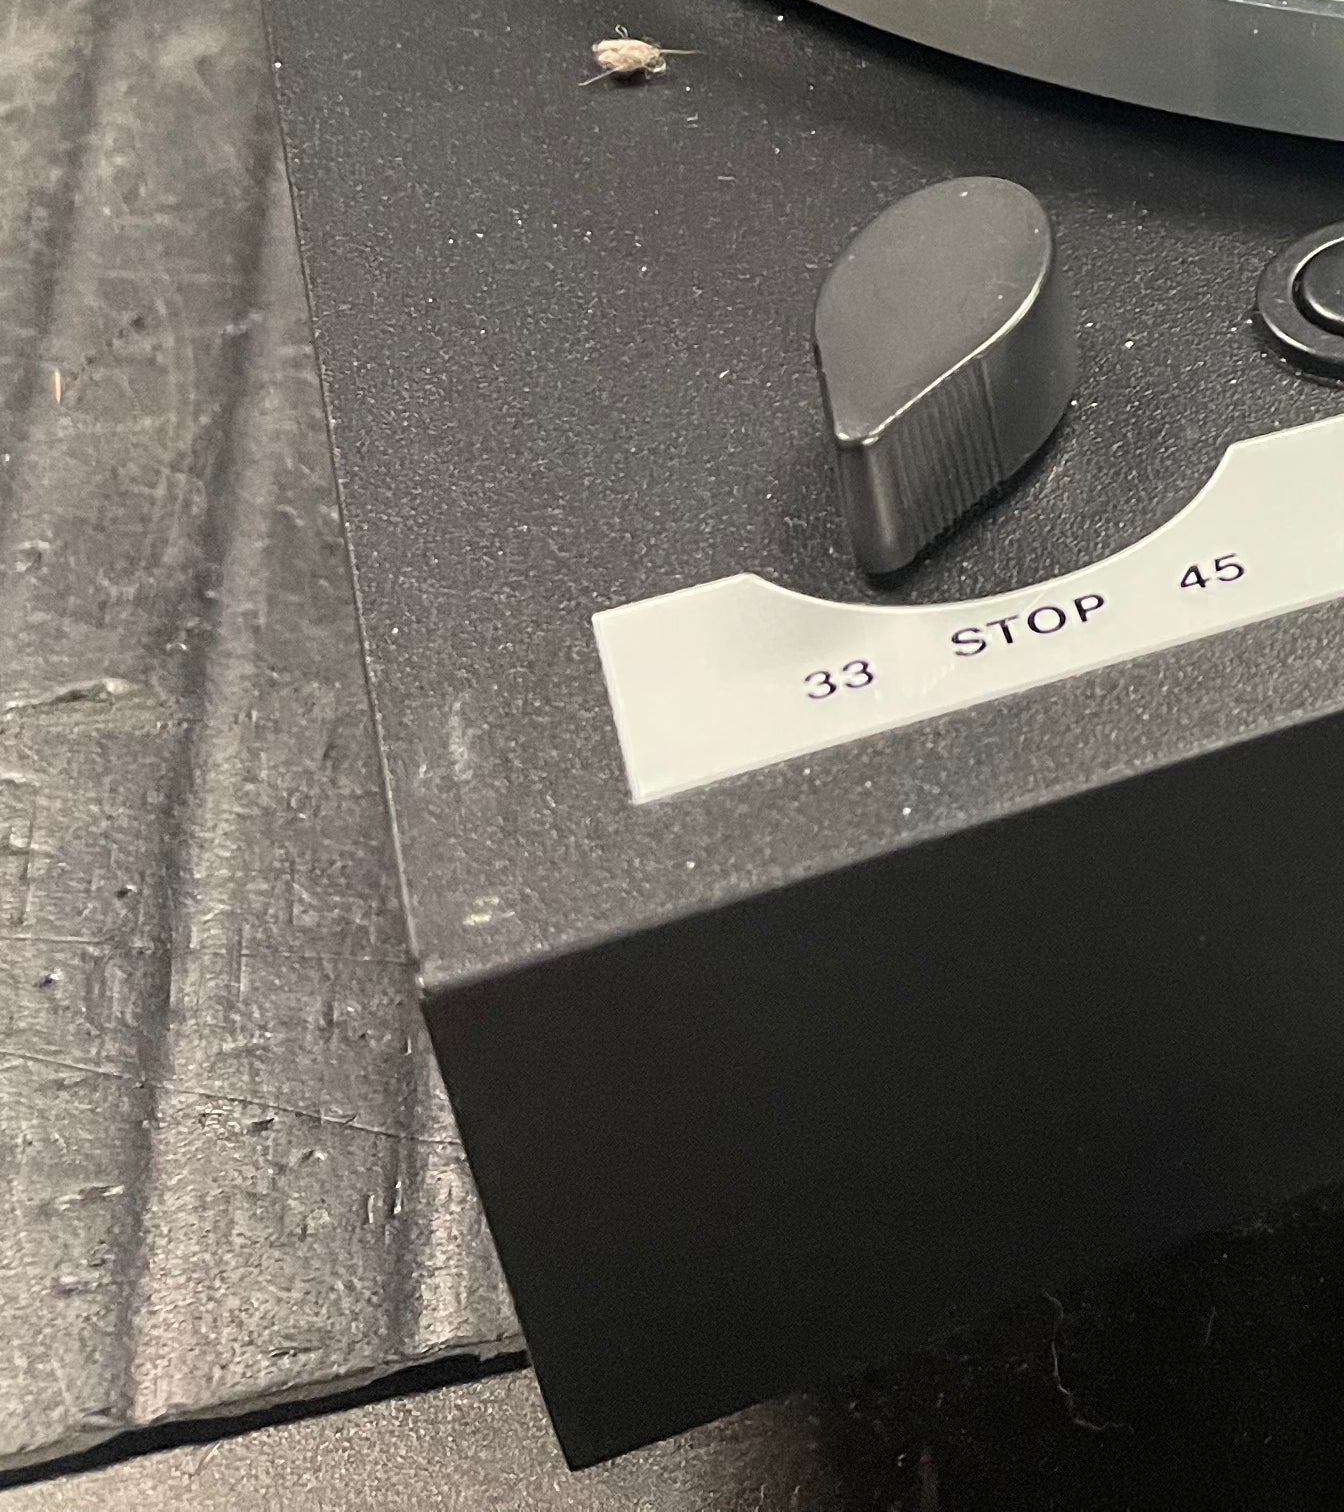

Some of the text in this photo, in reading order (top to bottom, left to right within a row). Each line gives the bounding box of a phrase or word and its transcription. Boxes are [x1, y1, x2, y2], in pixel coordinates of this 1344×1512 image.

[803, 553, 1246, 700] 33 STOP 45
